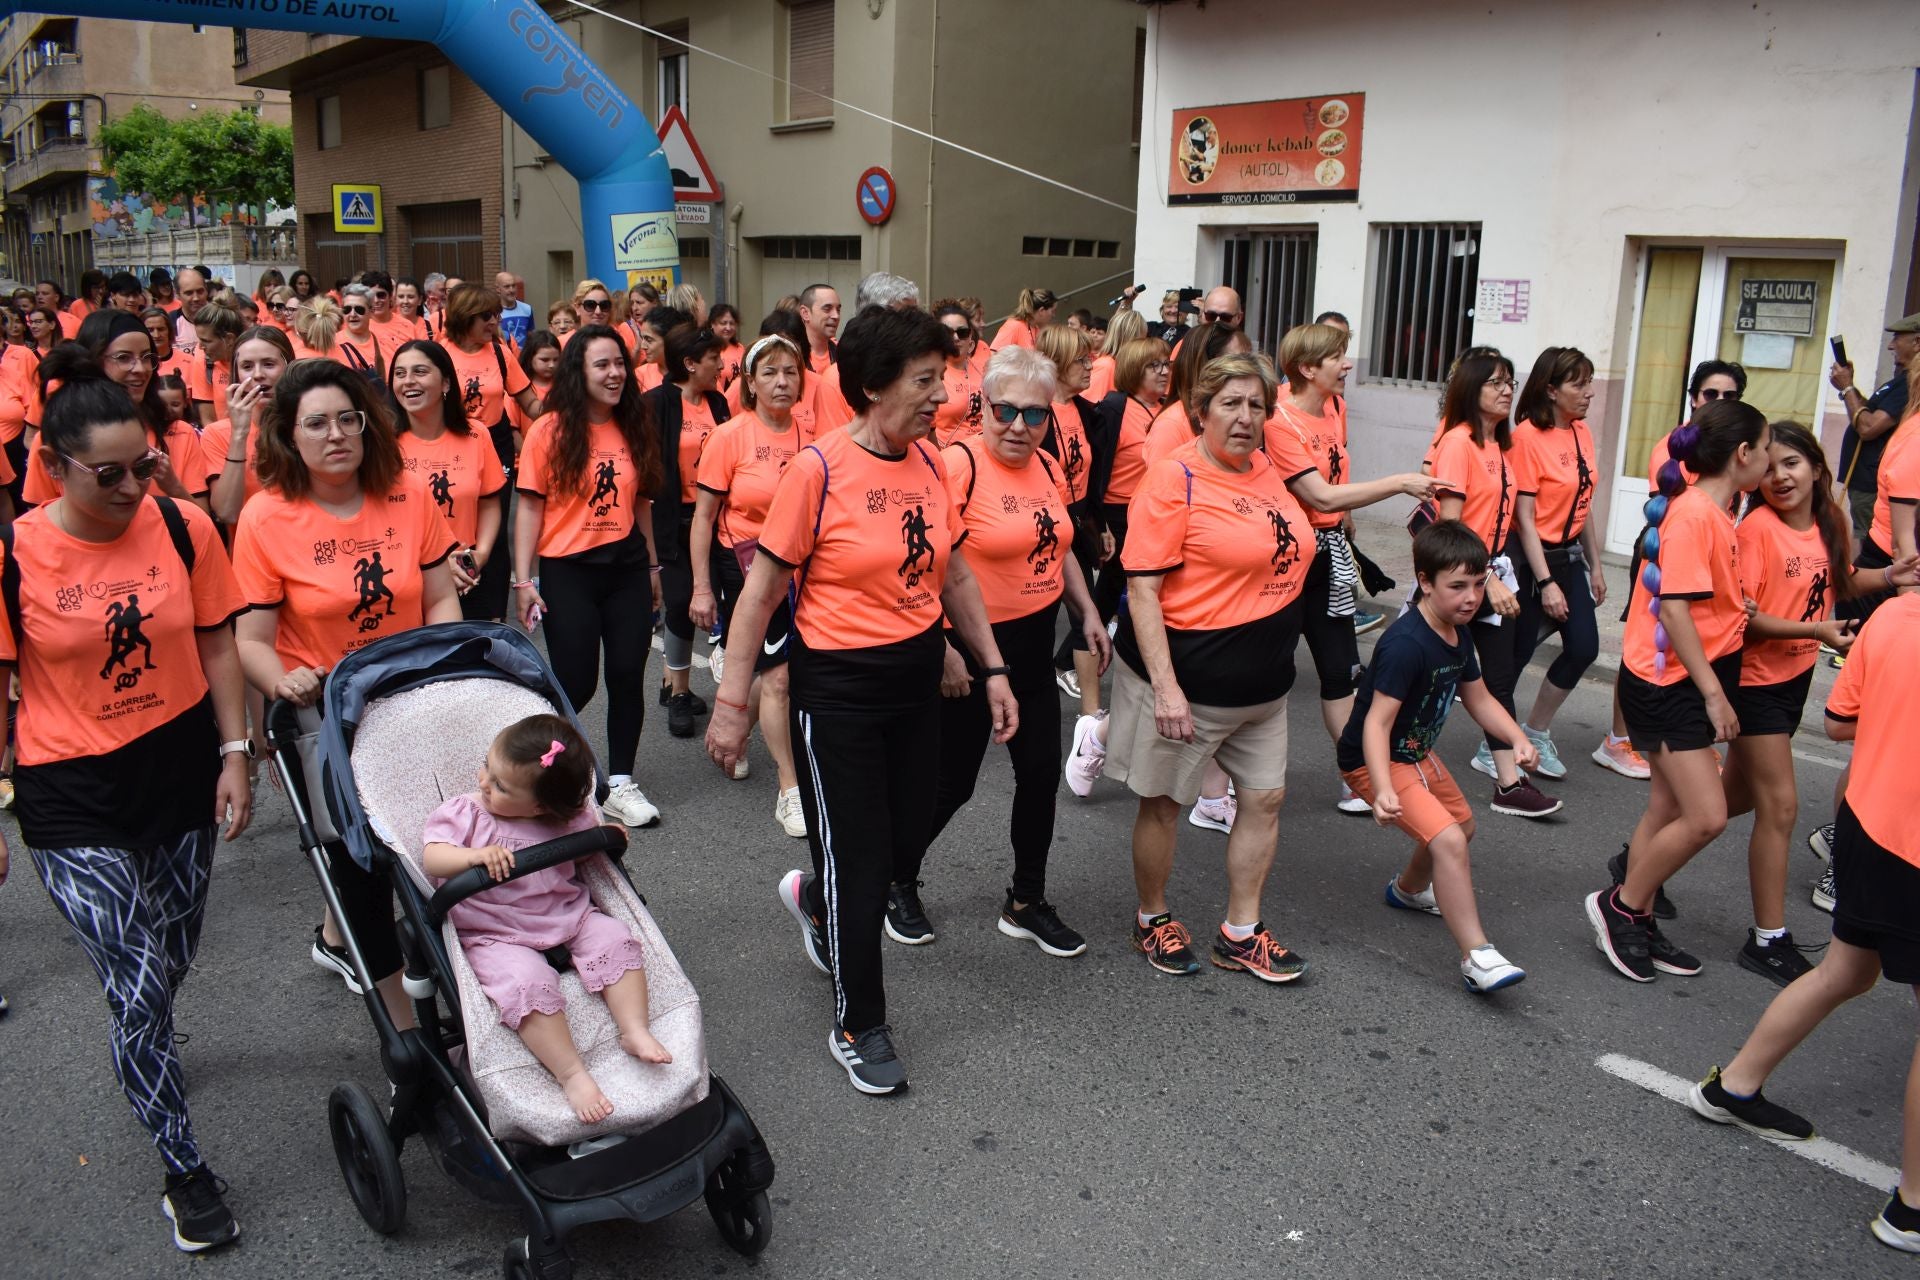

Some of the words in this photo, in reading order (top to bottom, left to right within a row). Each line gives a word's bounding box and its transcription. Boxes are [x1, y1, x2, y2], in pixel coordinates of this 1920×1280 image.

[285, 0, 318, 15] DE
[322, 1, 400, 23] AUTOL
[1221, 140, 1263, 155] doner
[1267, 136, 1313, 153] kebab
[1240, 162, 1289, 179] (AUTOL)
[1221, 194, 1251, 204] SERVICIO
[1253, 194, 1259, 203] A
[1260, 193, 1296, 203] DOMICILIO
[618, 223, 657, 254] Verona
[1743, 282, 1758, 299] SE
[1760, 283, 1812, 300] ALQUILA
[102, 703, 112, 712] IX
[114, 692, 157, 709] CARRERA
[96, 711, 126, 721] CONTRA
[127, 706, 136, 714] EL
